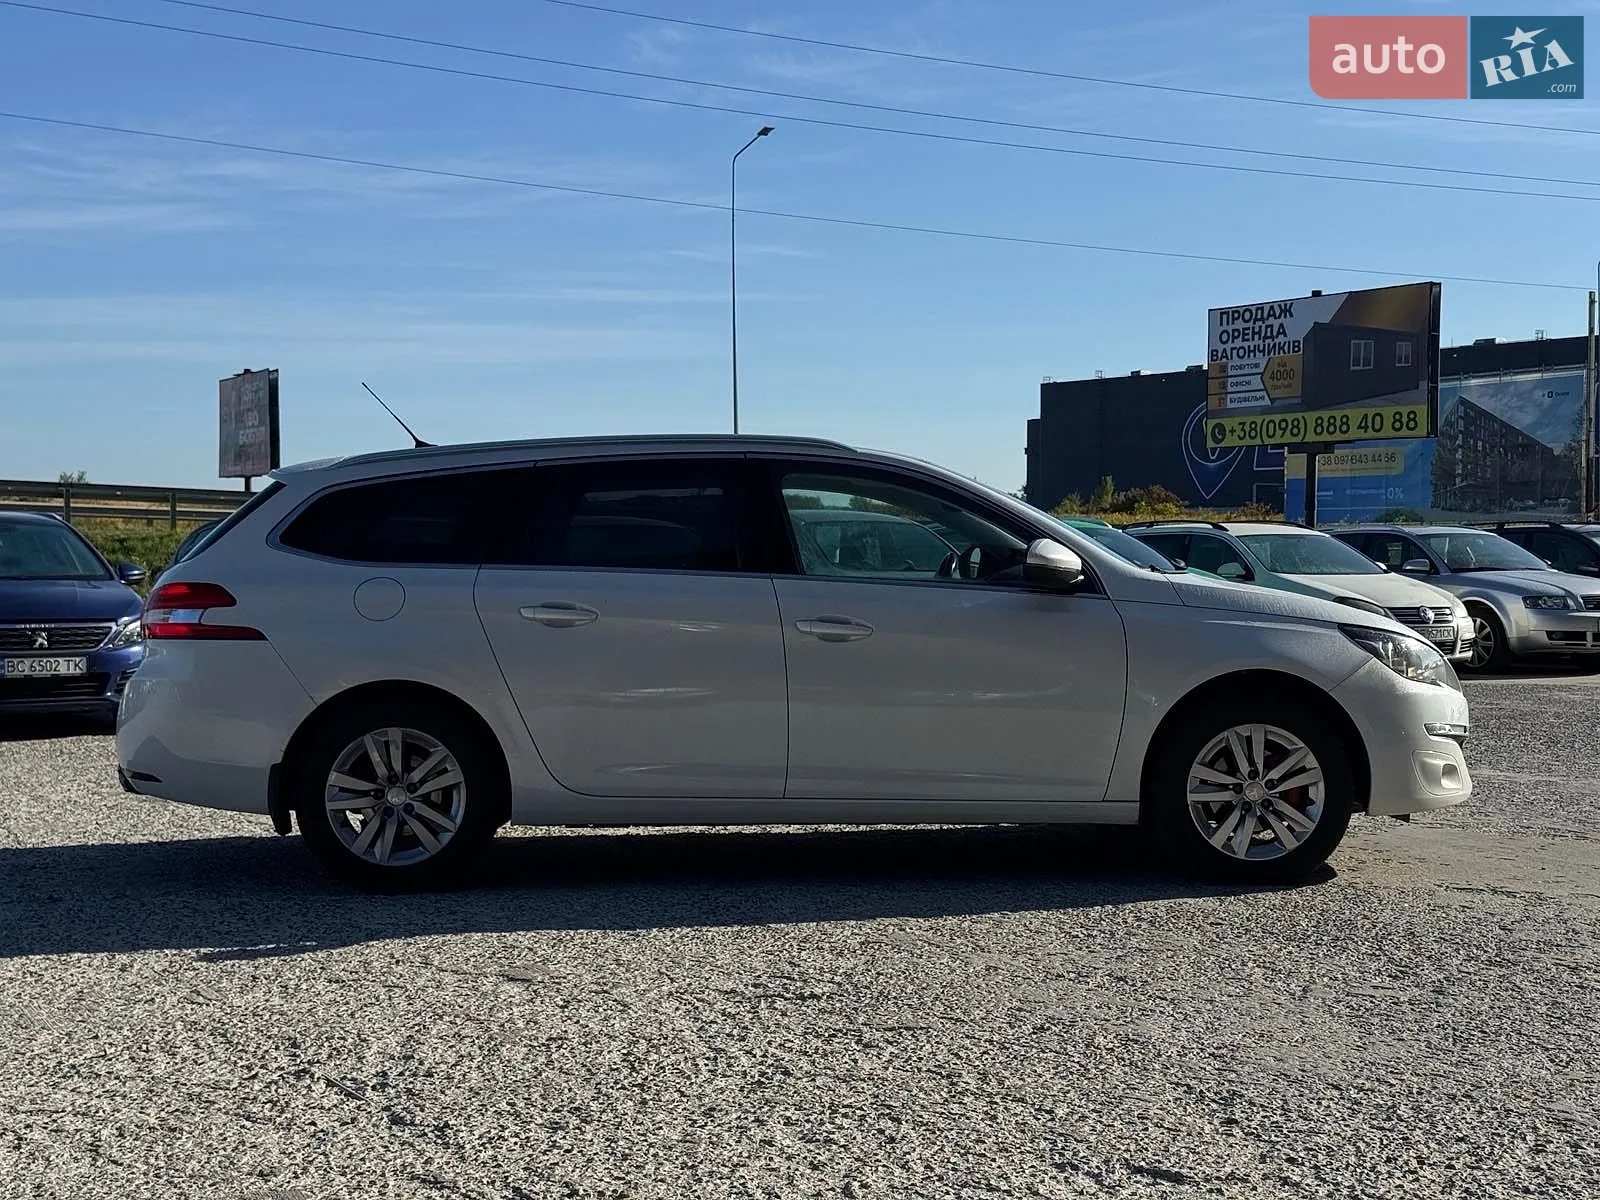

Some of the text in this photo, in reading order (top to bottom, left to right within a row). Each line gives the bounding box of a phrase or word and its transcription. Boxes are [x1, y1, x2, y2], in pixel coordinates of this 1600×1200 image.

[1219, 302, 1294, 327] ПРОДАЖ
[1218, 322, 1288, 345] ОРЕНДА
[1210, 340, 1302, 362] ВАГОНЧИКІВ
[1269, 368, 1295, 382] 4000
[1228, 410, 1418, 444] +38(098) 888 40 88
[7, 659, 83, 673] BC 6502 TK
